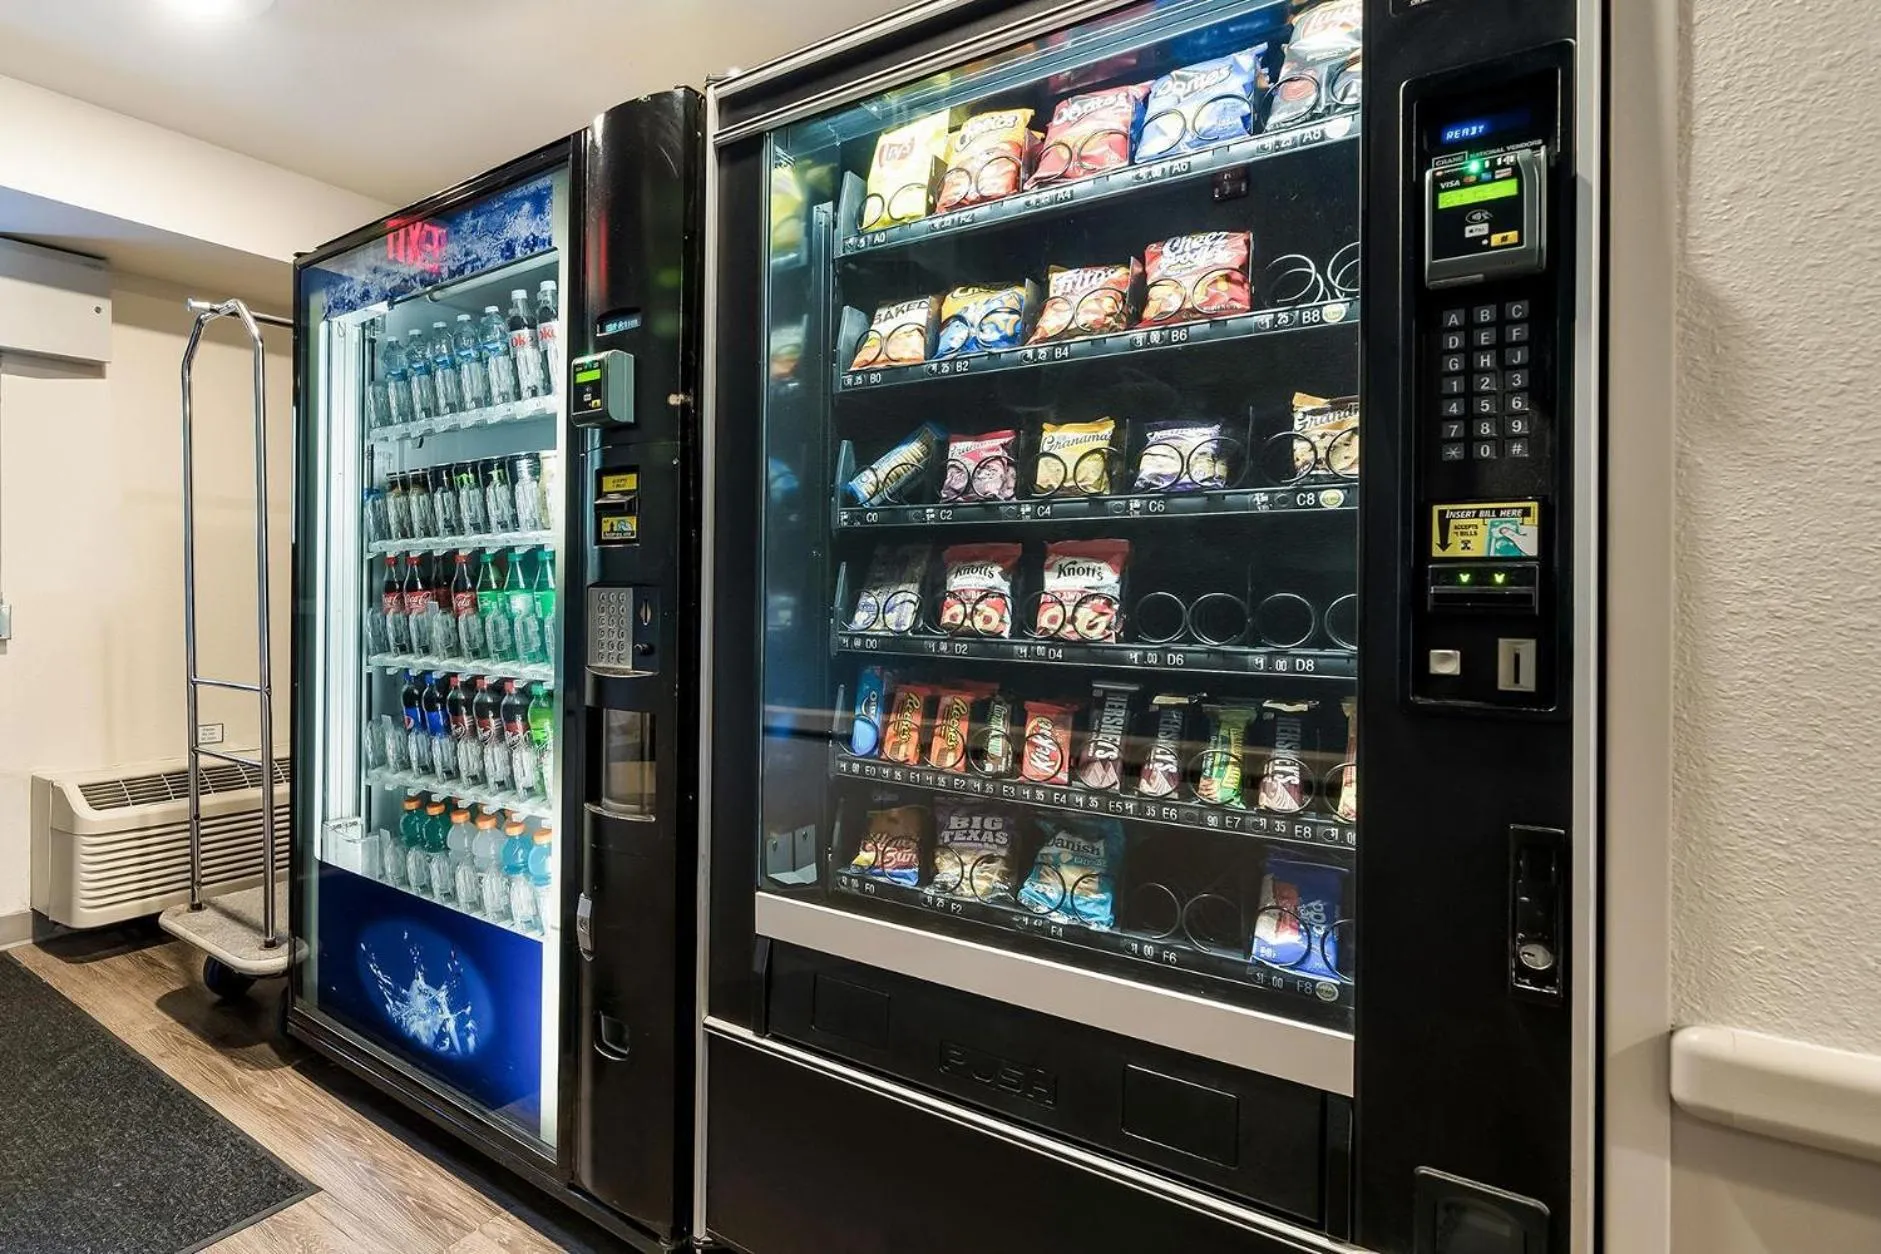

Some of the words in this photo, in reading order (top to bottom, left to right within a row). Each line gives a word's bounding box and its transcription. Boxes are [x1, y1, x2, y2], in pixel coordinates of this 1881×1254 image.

[1303, 128, 1320, 143] A8
[1172, 160, 1187, 173] A6
[1440, 179, 1460, 189] VISA
[1302, 309, 1320, 323] B8
[1449, 315, 1459, 325] A
[1481, 310, 1490, 322] B
[1513, 305, 1522, 317] C
[1171, 328, 1187, 342] B6
[1449, 337, 1459, 348] D
[1481, 333, 1490, 344] E
[1513, 328, 1521, 340] F
[1055, 346, 1068, 358] B4
[956, 360, 968, 372] B2
[1449, 359, 1459, 370] G
[1480, 355, 1491, 366] H
[1513, 351, 1521, 363] J
[1452, 381, 1457, 392] 1
[1480, 377, 1490, 389] 2
[1512, 374, 1522, 386] 3
[1449, 403, 1458, 414] 4
[1480, 400, 1490, 412] 5
[1512, 397, 1522, 409] 6
[1449, 425, 1458, 437] 7
[1480, 423, 1490, 434] 8
[1512, 420, 1522, 432] 9
[1481, 445, 1490, 456] 0
[1512, 443, 1522, 455] #
[1296, 492, 1314, 505] C8
[1037, 505, 1050, 516] C4
[1149, 500, 1164, 512] C6
[866, 512, 878, 522] C0
[940, 509, 952, 519] C2
[1446, 510, 1476, 518] INSERT
[1500, 509, 1523, 517] HERE
[954, 643, 967, 654] D2
[1048, 648, 1062, 659] D4
[1167, 653, 1183, 665] D6
[1295, 658, 1314, 671] D8
[910, 772, 920, 782] E1
[953, 778, 965, 790] E2
[1002, 785, 1015, 796] E3
[1053, 792, 1066, 804] E4
[1109, 800, 1122, 813] E5
[1162, 807, 1177, 820] E6
[1225, 816, 1241, 828] E7
[1294, 824, 1311, 838] E8
[950, 816, 1003, 830] BIG
[942, 830, 1008, 845] TEXAS
[951, 902, 962, 914] F2
[1051, 925, 1062, 937] F4
[1163, 950, 1176, 964] F6
[1297, 979, 1312, 994] F8
